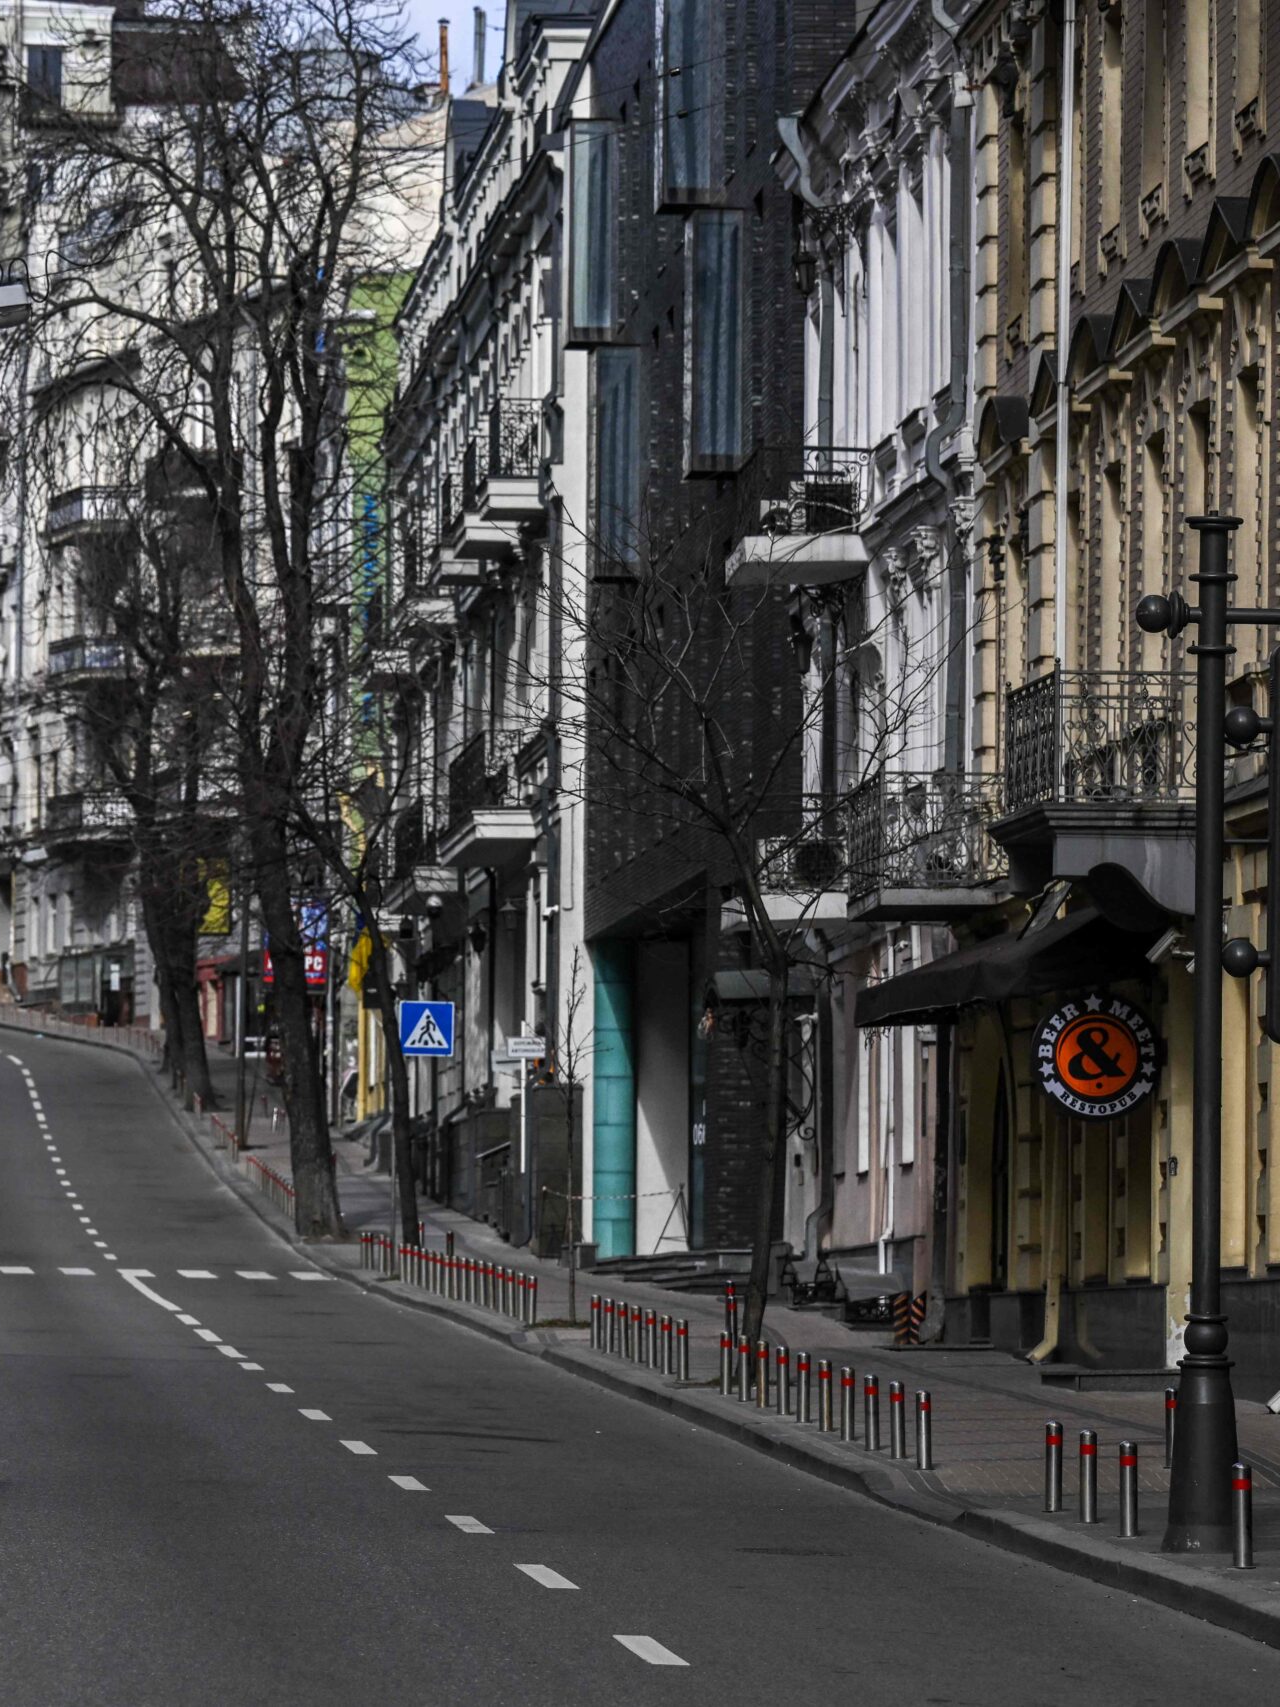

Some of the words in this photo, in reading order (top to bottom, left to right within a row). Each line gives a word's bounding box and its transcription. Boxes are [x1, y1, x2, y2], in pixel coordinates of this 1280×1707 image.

[1038, 1003, 1080, 1059] BEER
[1108, 1000, 1155, 1057] MEET
[1059, 1091, 1137, 1115] RESTOPUB
